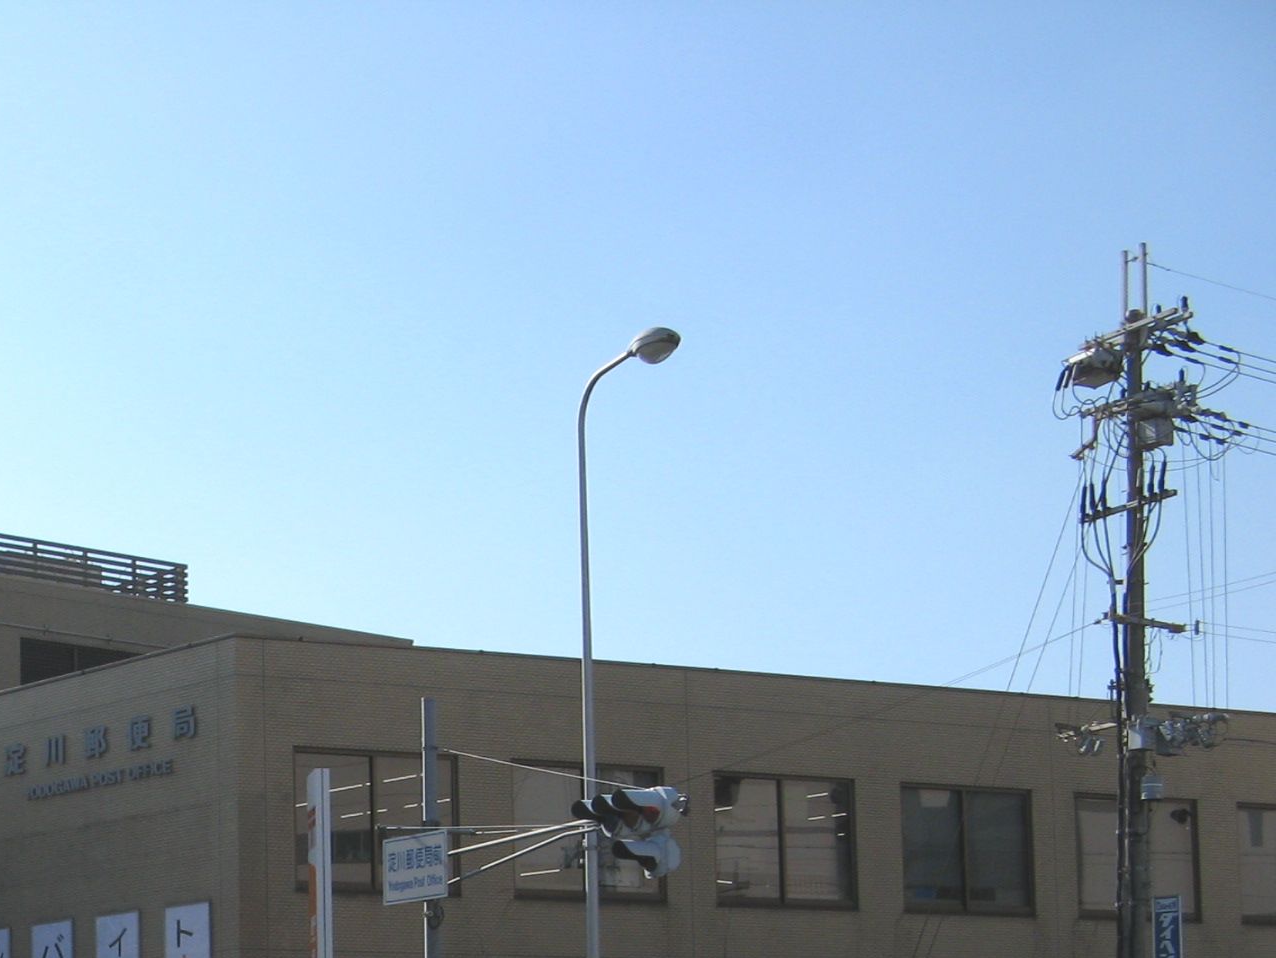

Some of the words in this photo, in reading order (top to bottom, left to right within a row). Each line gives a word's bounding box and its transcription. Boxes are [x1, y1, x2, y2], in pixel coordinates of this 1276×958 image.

[3, 703, 197, 777] 淀川郵便局
[91, 766, 126, 787] POST
[127, 758, 174, 781] OFFICE
